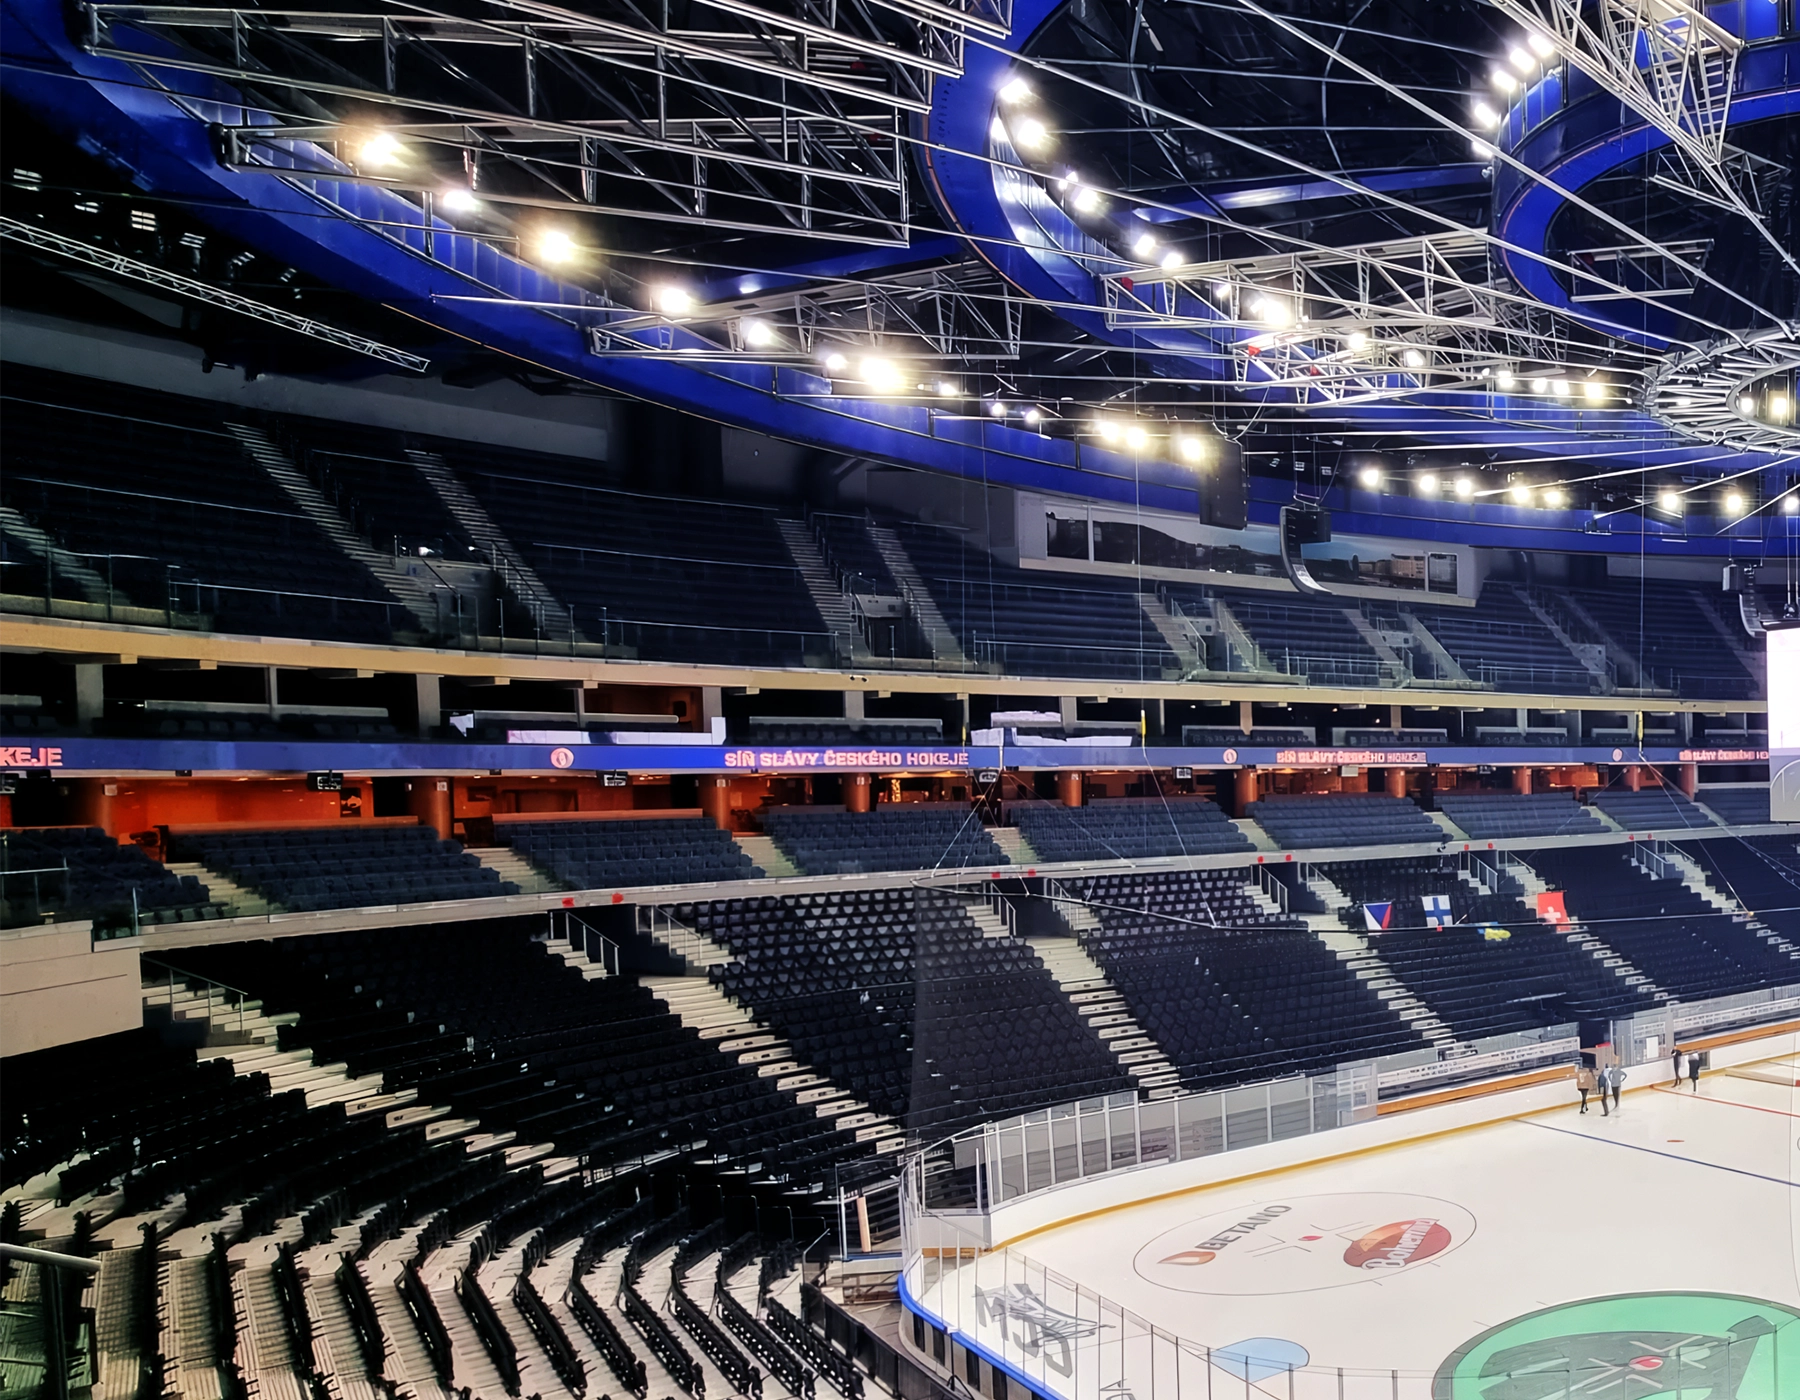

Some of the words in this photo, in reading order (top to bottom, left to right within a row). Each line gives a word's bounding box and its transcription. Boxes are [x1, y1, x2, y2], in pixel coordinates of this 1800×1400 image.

[760, 750, 819, 767] SLÁVY
[823, 750, 902, 766] ČESKÉHO
[907, 752, 969, 766] HOKEJE
[1194, 1204, 1293, 1251] BETANO
